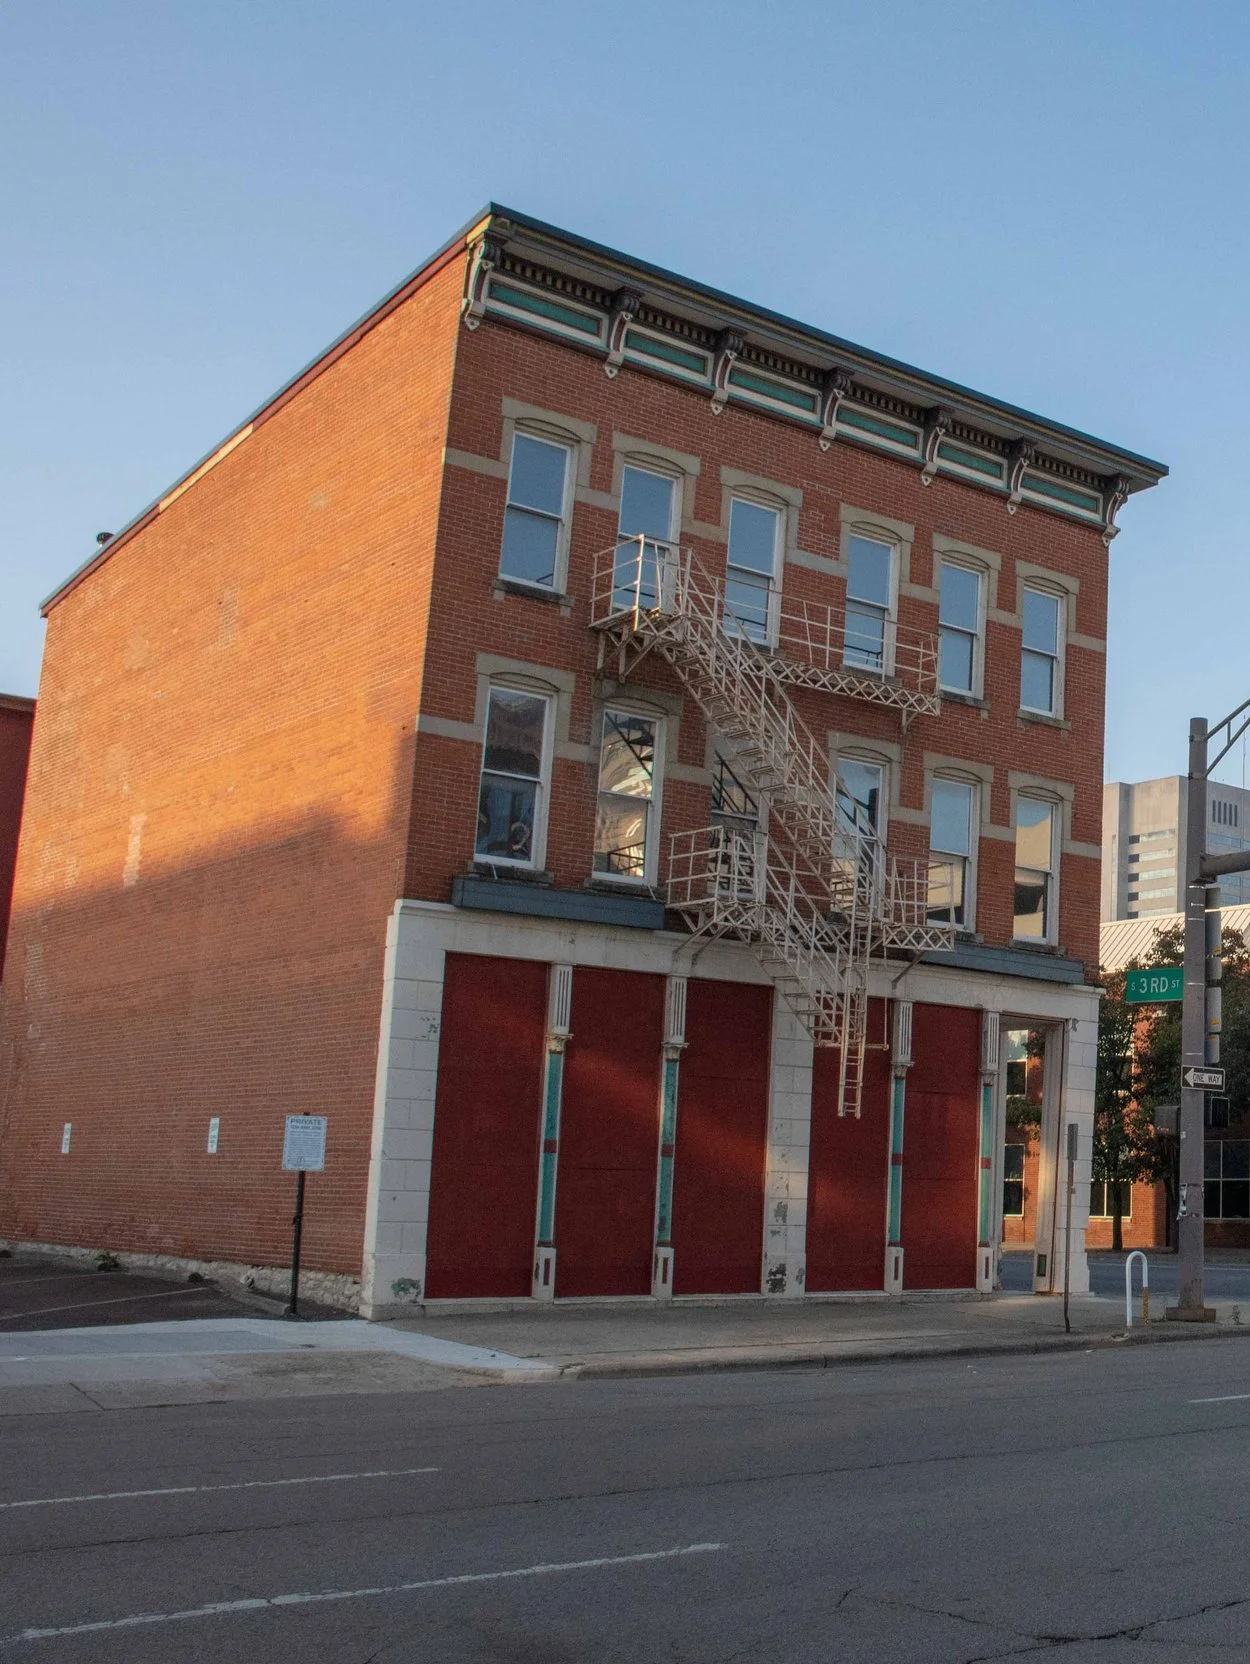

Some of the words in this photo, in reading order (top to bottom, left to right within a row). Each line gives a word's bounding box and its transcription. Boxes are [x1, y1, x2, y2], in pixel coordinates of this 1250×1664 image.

[1139, 977, 1168, 994] 3RD
[1171, 979, 1180, 989] ST
[1192, 1073, 1204, 1082] ONE
[1207, 1074, 1220, 1083] WAY
[290, 1118, 321, 1126] PRIVATE
